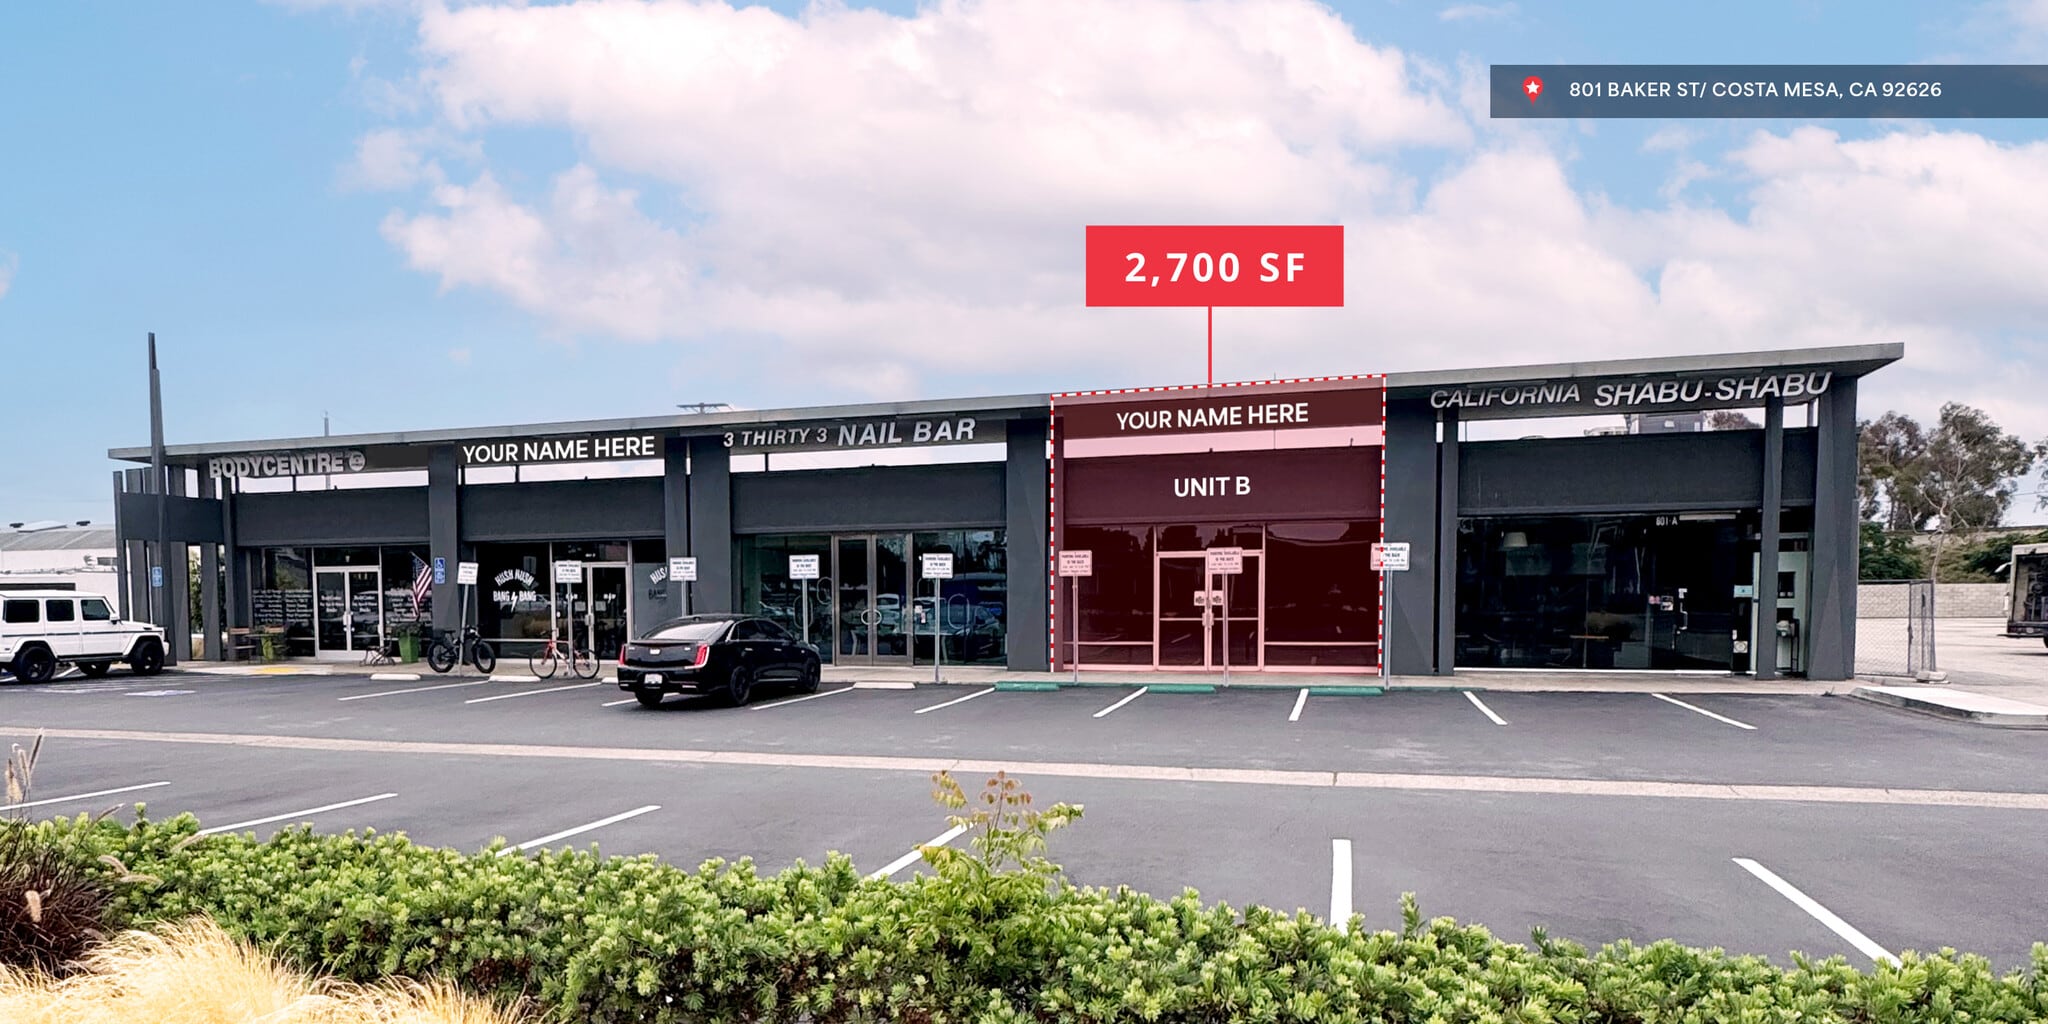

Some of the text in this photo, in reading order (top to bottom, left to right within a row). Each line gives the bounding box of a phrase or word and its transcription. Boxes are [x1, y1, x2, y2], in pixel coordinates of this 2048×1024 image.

[1430, 383, 1581, 409] CALIFORNIA
[723, 417, 977, 448] 3 THIRTY 3 NAIL BAR
[208, 451, 344, 479] BODYCENTRE
[494, 568, 514, 586] HUSH
[515, 568, 535, 586] HUSH
[493, 590, 536, 602] BANG BANG
